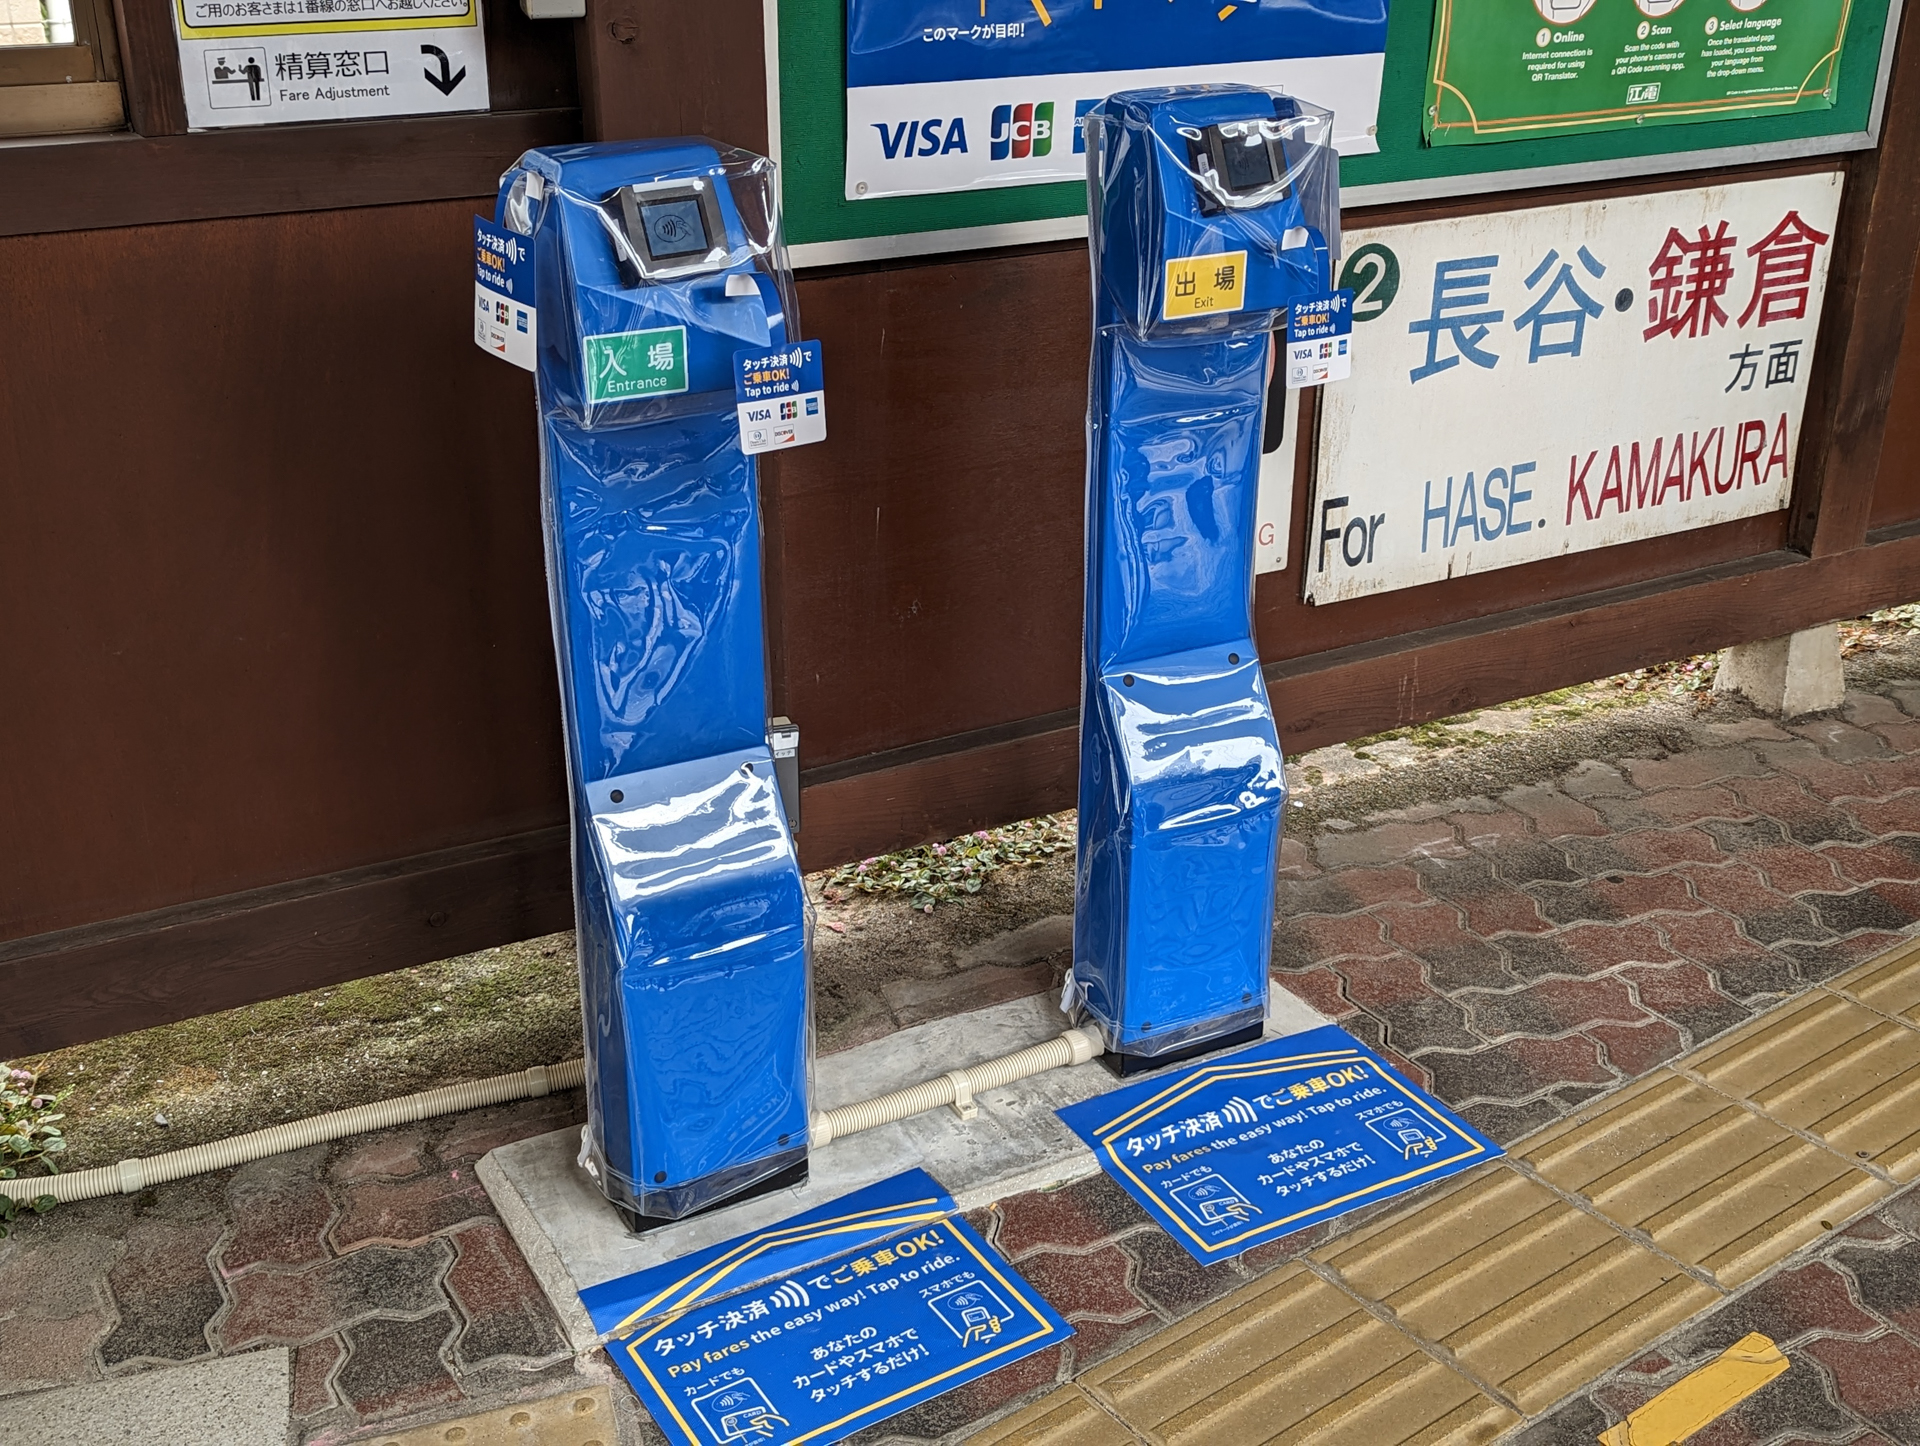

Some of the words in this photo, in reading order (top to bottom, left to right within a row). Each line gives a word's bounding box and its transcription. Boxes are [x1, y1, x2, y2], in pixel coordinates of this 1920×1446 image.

[923, 23, 1025, 42] このマークが目印!
[1651, 25, 1672, 35] Scan
[1720, 19, 1743, 30] Select
[1744, 18, 1782, 30] language
[1553, 31, 1585, 43] Online
[1707, 38, 1723, 46] Once
[1733, 35, 1760, 44] translated
[1760, 34, 1775, 42] page
[1522, 51, 1549, 60] Internet
[1550, 49, 1586, 58] connection
[1587, 48, 1593, 56] is
[1624, 44, 1639, 53] Scan
[1640, 43, 1650, 51] the
[1650, 42, 1665, 50] code
[1667, 41, 1680, 49] with
[1713, 48, 1733, 56] loaded,
[275, 50, 390, 81] 精算窓口
[1527, 62, 1556, 71] required
[1557, 61, 1567, 69] for
[1567, 60, 1585, 69] using
[1615, 57, 1629, 66] your
[1629, 54, 1653, 64] phone's
[1654, 52, 1677, 60] camera
[1711, 60, 1724, 68] your
[1724, 58, 1749, 66] language
[1531, 73, 1543, 82] QR
[1544, 71, 1578, 81] Translator.
[1616, 67, 1627, 75] QR
[1627, 65, 1643, 74] Code
[1643, 63, 1671, 72] scanning
[1671, 63, 1685, 71] app.
[1706, 70, 1716, 78] the
[1717, 68, 1747, 77] drop-down
[280, 89, 309, 101] Fare
[316, 85, 390, 101] Adjustment
[870, 117, 968, 160] VISA
[477, 263, 486, 281] Tap
[485, 272, 491, 282] to
[492, 273, 505, 287] ride
[1353, 253, 1385, 314] 2
[1194, 296, 1214, 308] Exit
[1295, 300, 1329, 315] タッチ決済
[1341, 298, 1347, 308] で
[1409, 210, 1830, 385] 長谷・鎌倉
[1294, 312, 1330, 327] ご乗車OK!
[1294, 329, 1307, 339] Tap
[1307, 328, 1315, 336] to
[1316, 325, 1328, 335] ride
[743, 354, 788, 371] タッチ決済
[803, 351, 812, 362] で
[1293, 349, 1313, 360] VISA
[1725, 339, 1803, 393] 方面
[607, 377, 667, 393] Entrance
[743, 368, 790, 386] ご乗車OK!
[745, 387, 761, 398] Tap
[762, 386, 771, 394] to
[773, 382, 789, 393] ride
[746, 409, 771, 422] VISA
[1320, 496, 1384, 573] For
[1566, 413, 1787, 525] KAMAKURA
[1126, 1111, 1224, 1157] タッチ決済
[1252, 1065, 1369, 1109] でご乗車OK!
[1355, 1099, 1404, 1120] スマホでも
[1142, 1159, 1172, 1174] Pay
[1171, 1146, 1212, 1164] fares
[1211, 1136, 1238, 1150] the
[1239, 1123, 1272, 1142] easy
[1272, 1110, 1309, 1128] way!
[1306, 1103, 1336, 1116] Tap
[1335, 1097, 1352, 1107] to
[1352, 1086, 1387, 1102] ride.
[1267, 1138, 1325, 1165] あなたの
[1257, 1141, 1364, 1186] カードやスマホで
[1160, 1165, 1212, 1189] カードでも
[1275, 1154, 1376, 1197] タッチするだけ!
[654, 1299, 770, 1357] タッチ決済
[807, 1229, 944, 1290] でご乗車OK!
[919, 1271, 975, 1299] スマホでも
[667, 1358, 702, 1378] Pay
[703, 1340, 750, 1364] fares
[750, 1326, 781, 1344] the
[784, 1307, 822, 1330] easy
[824, 1288, 867, 1313] way!
[866, 1277, 900, 1296] Tap
[900, 1270, 919, 1283] to
[921, 1255, 960, 1275] ride.
[810, 1326, 877, 1361] あなたの
[792, 1328, 919, 1389] カードやスマホで
[684, 1367, 745, 1397] カードでも
[810, 1343, 930, 1403] タッチするだけ!
[743, 1410, 762, 1419] CARD
